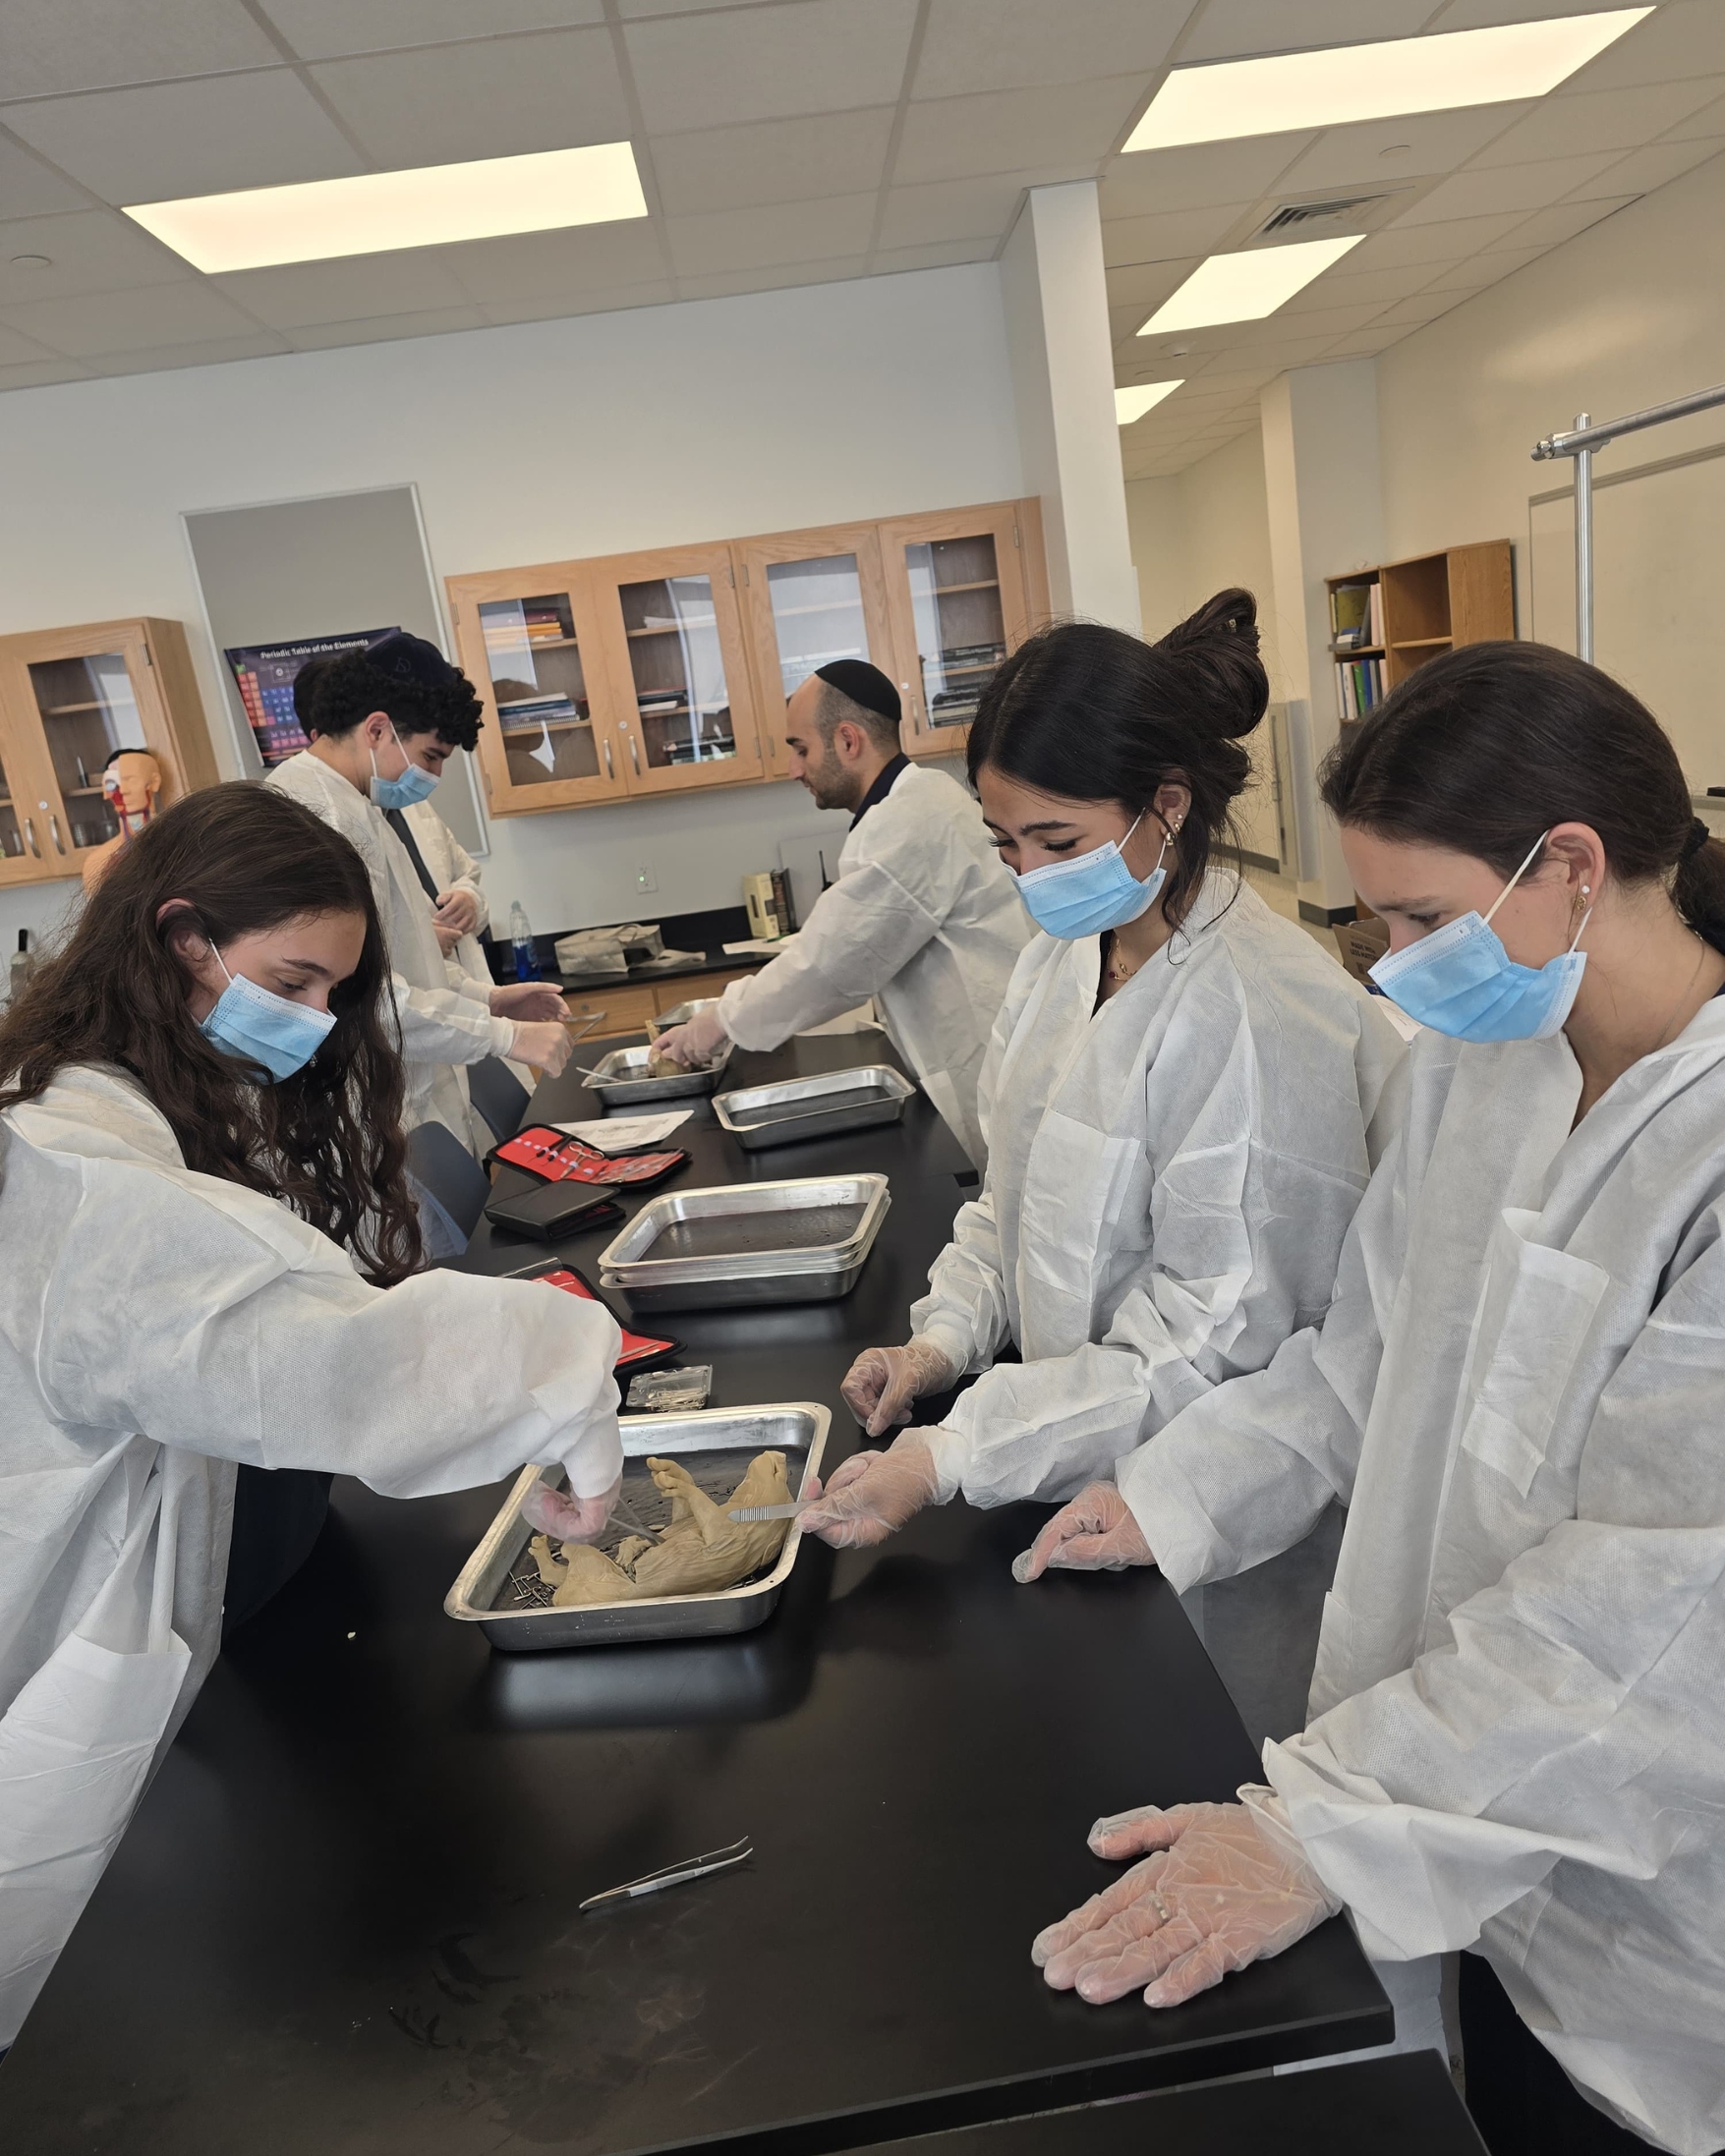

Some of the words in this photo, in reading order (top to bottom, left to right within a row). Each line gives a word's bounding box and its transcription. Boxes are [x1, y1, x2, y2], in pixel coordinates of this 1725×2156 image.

[259, 649, 291, 659] Periodic
[291, 646, 312, 656] Table
[312, 644, 320, 653] of
[319, 643, 333, 652] the
[333, 639, 370, 651] Elements
